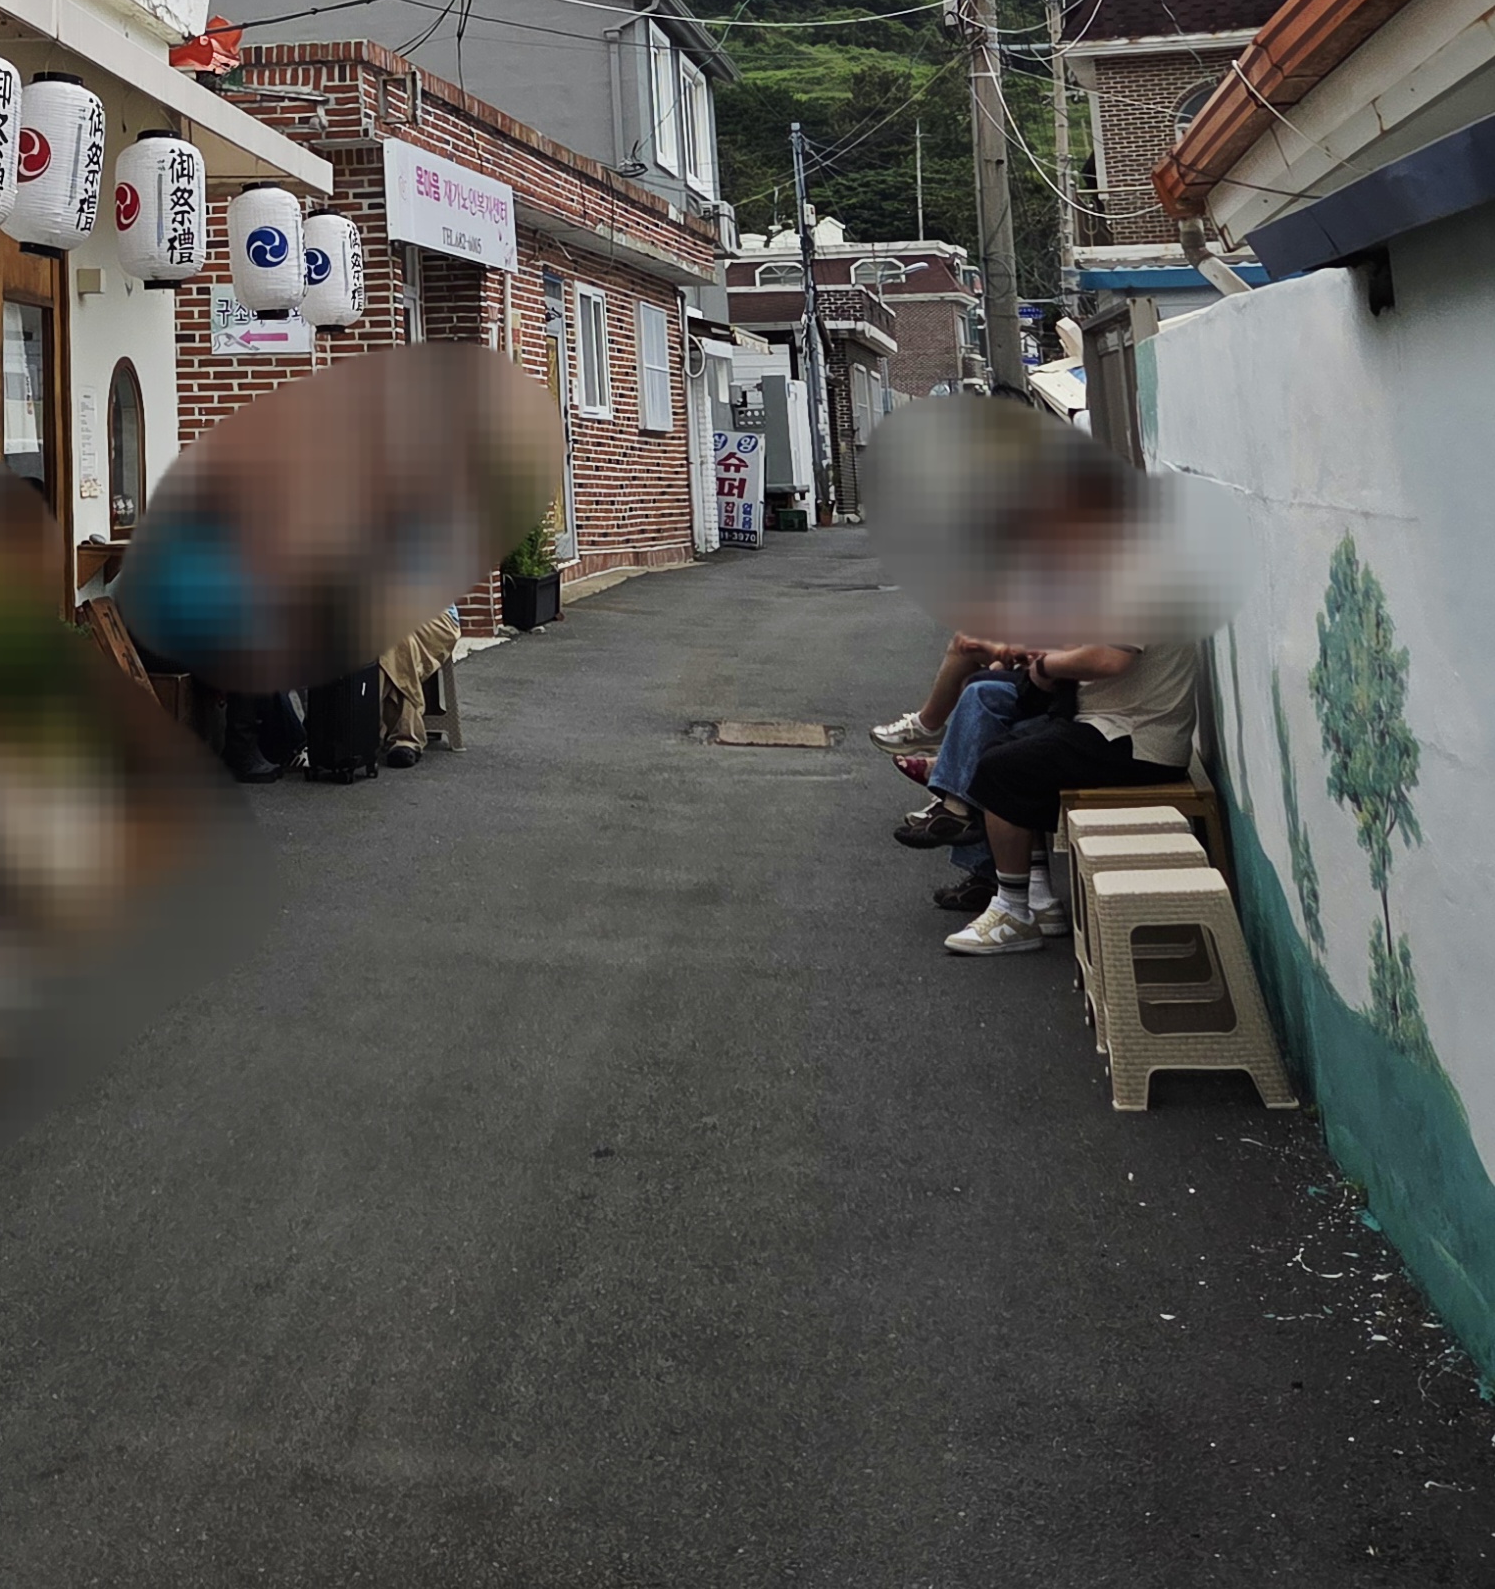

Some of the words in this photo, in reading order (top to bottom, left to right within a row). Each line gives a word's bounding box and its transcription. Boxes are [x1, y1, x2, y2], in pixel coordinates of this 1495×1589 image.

[167, 147, 195, 265] 御祭禮
[716, 452, 748, 498] 슈퍼
